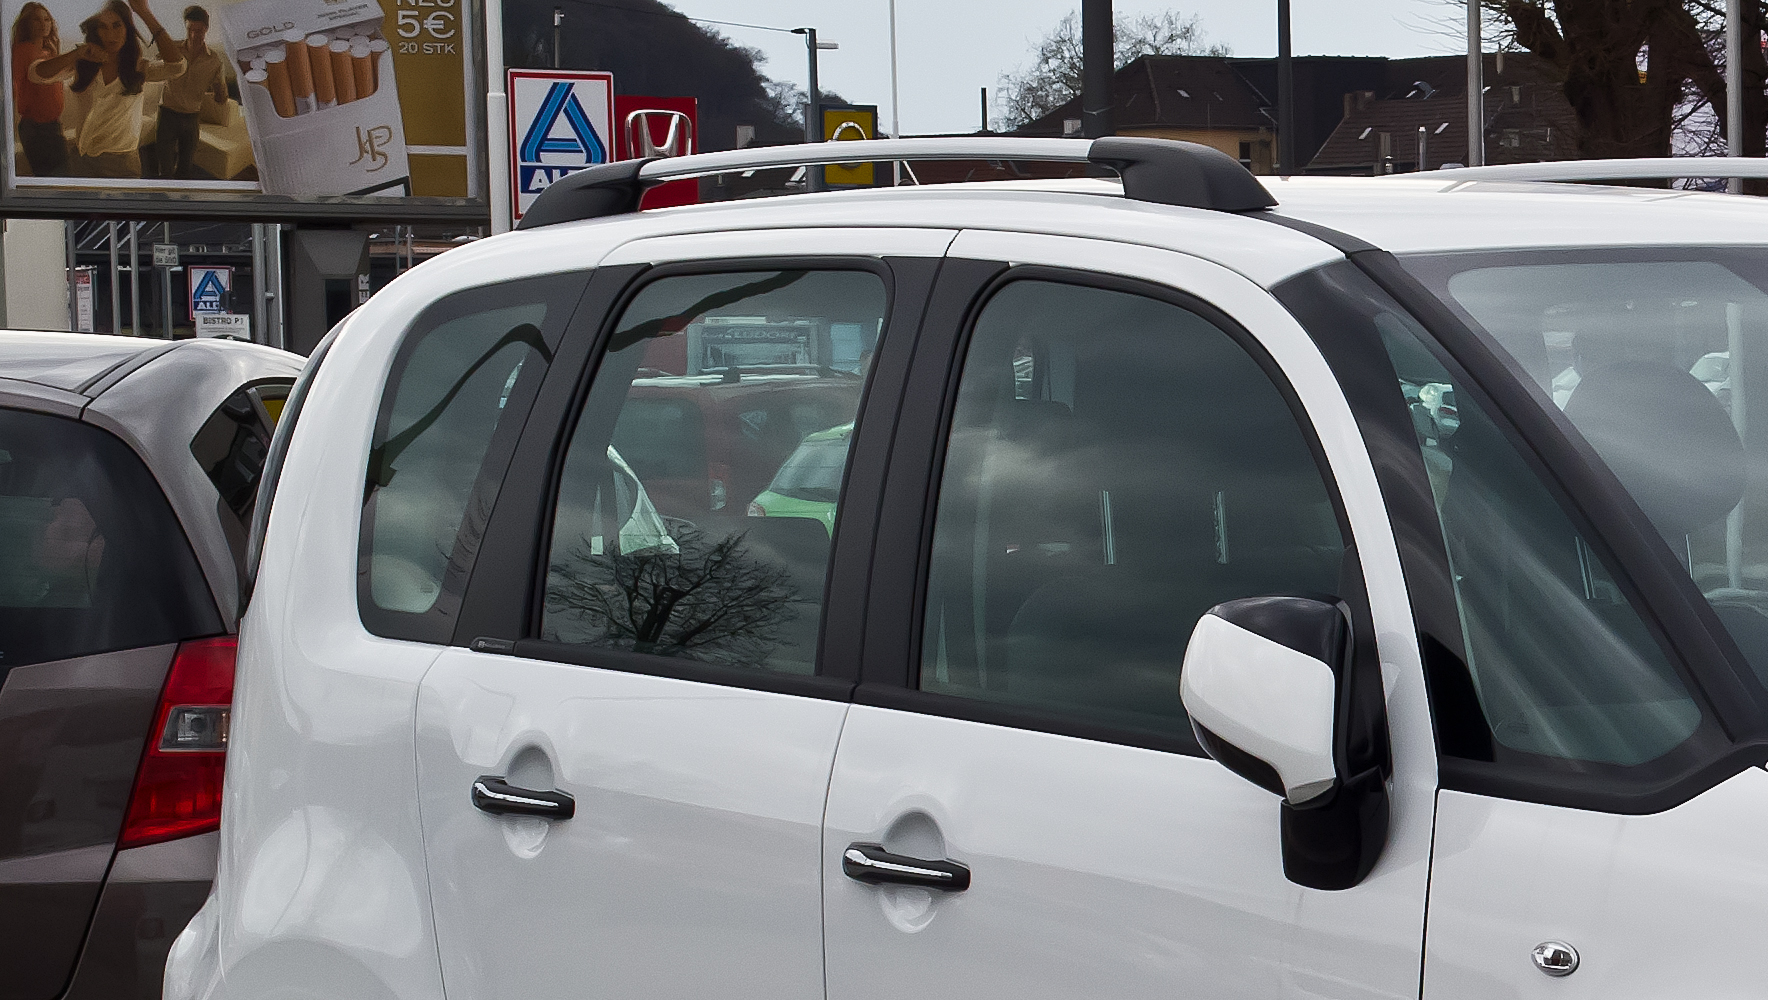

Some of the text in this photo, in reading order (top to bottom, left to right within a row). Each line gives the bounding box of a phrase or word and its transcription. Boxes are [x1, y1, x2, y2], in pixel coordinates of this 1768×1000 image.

[246, 21, 296, 40] GOLD
[397, 10, 456, 39] 5€
[399, 41, 456, 55] 20 STK
[203, 316, 232, 325] BISTRO
